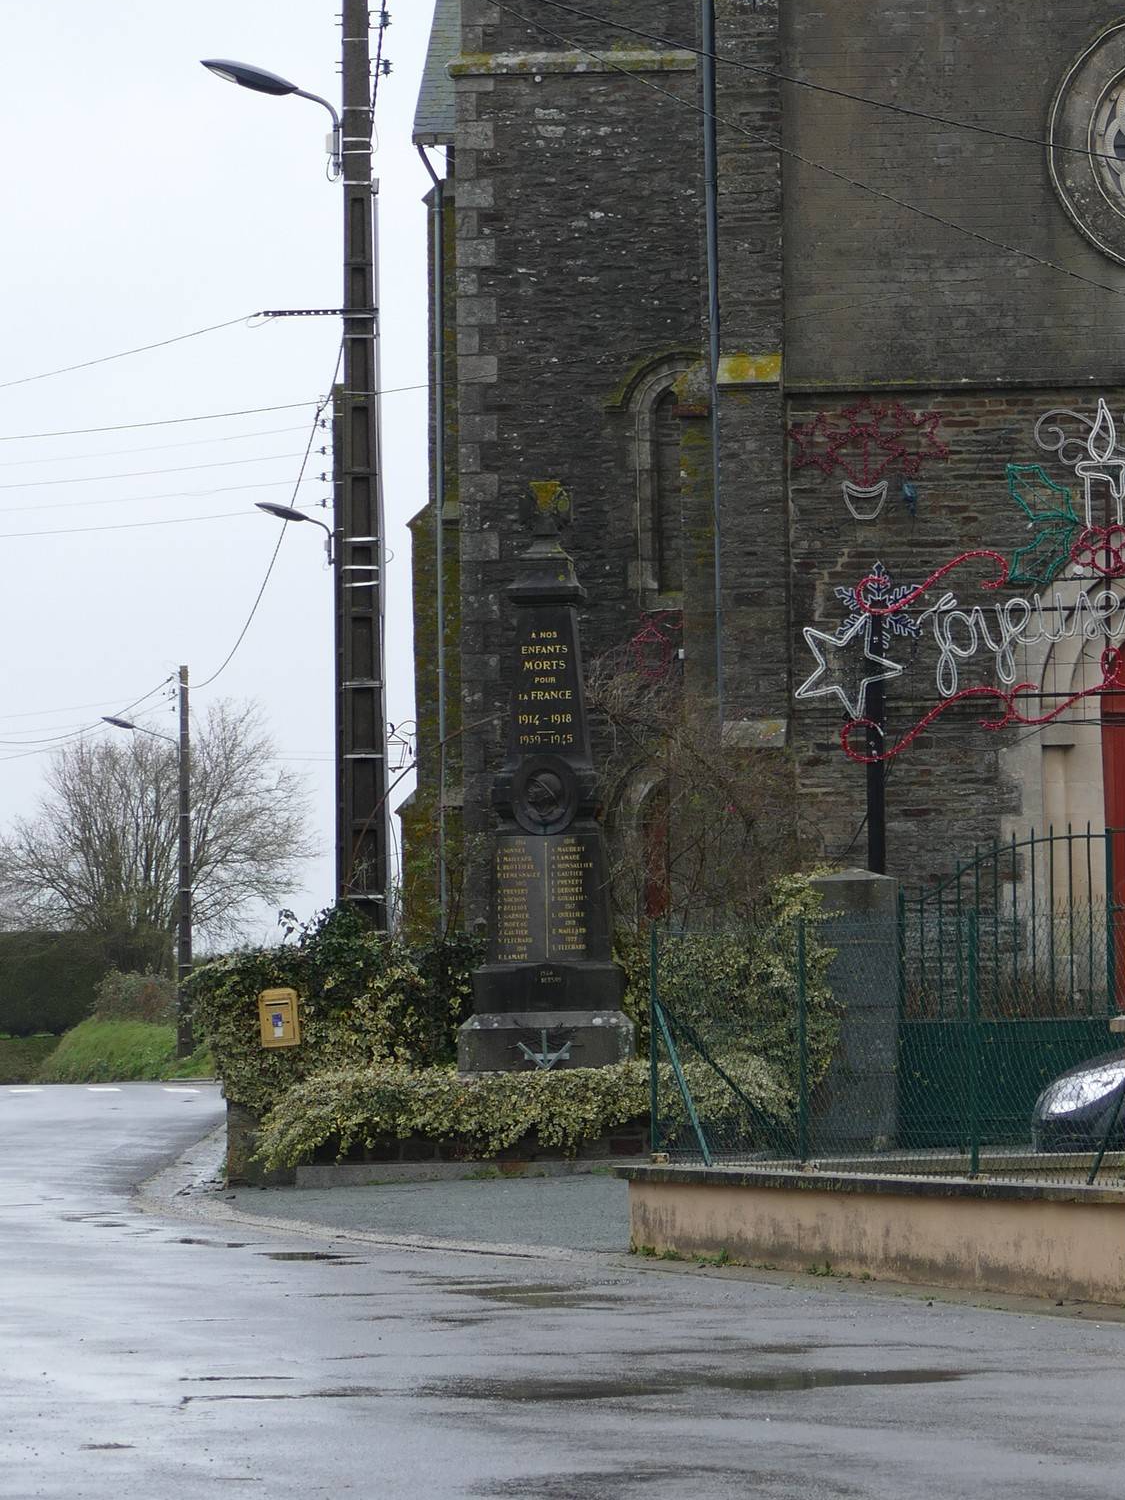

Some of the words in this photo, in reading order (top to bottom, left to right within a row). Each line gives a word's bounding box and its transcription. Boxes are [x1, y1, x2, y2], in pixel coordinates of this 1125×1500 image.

[540, 631, 558, 639] NOS
[521, 645, 568, 655] ENFANTS
[523, 660, 567, 670] MORTS
[530, 690, 573, 700] FRANCE
